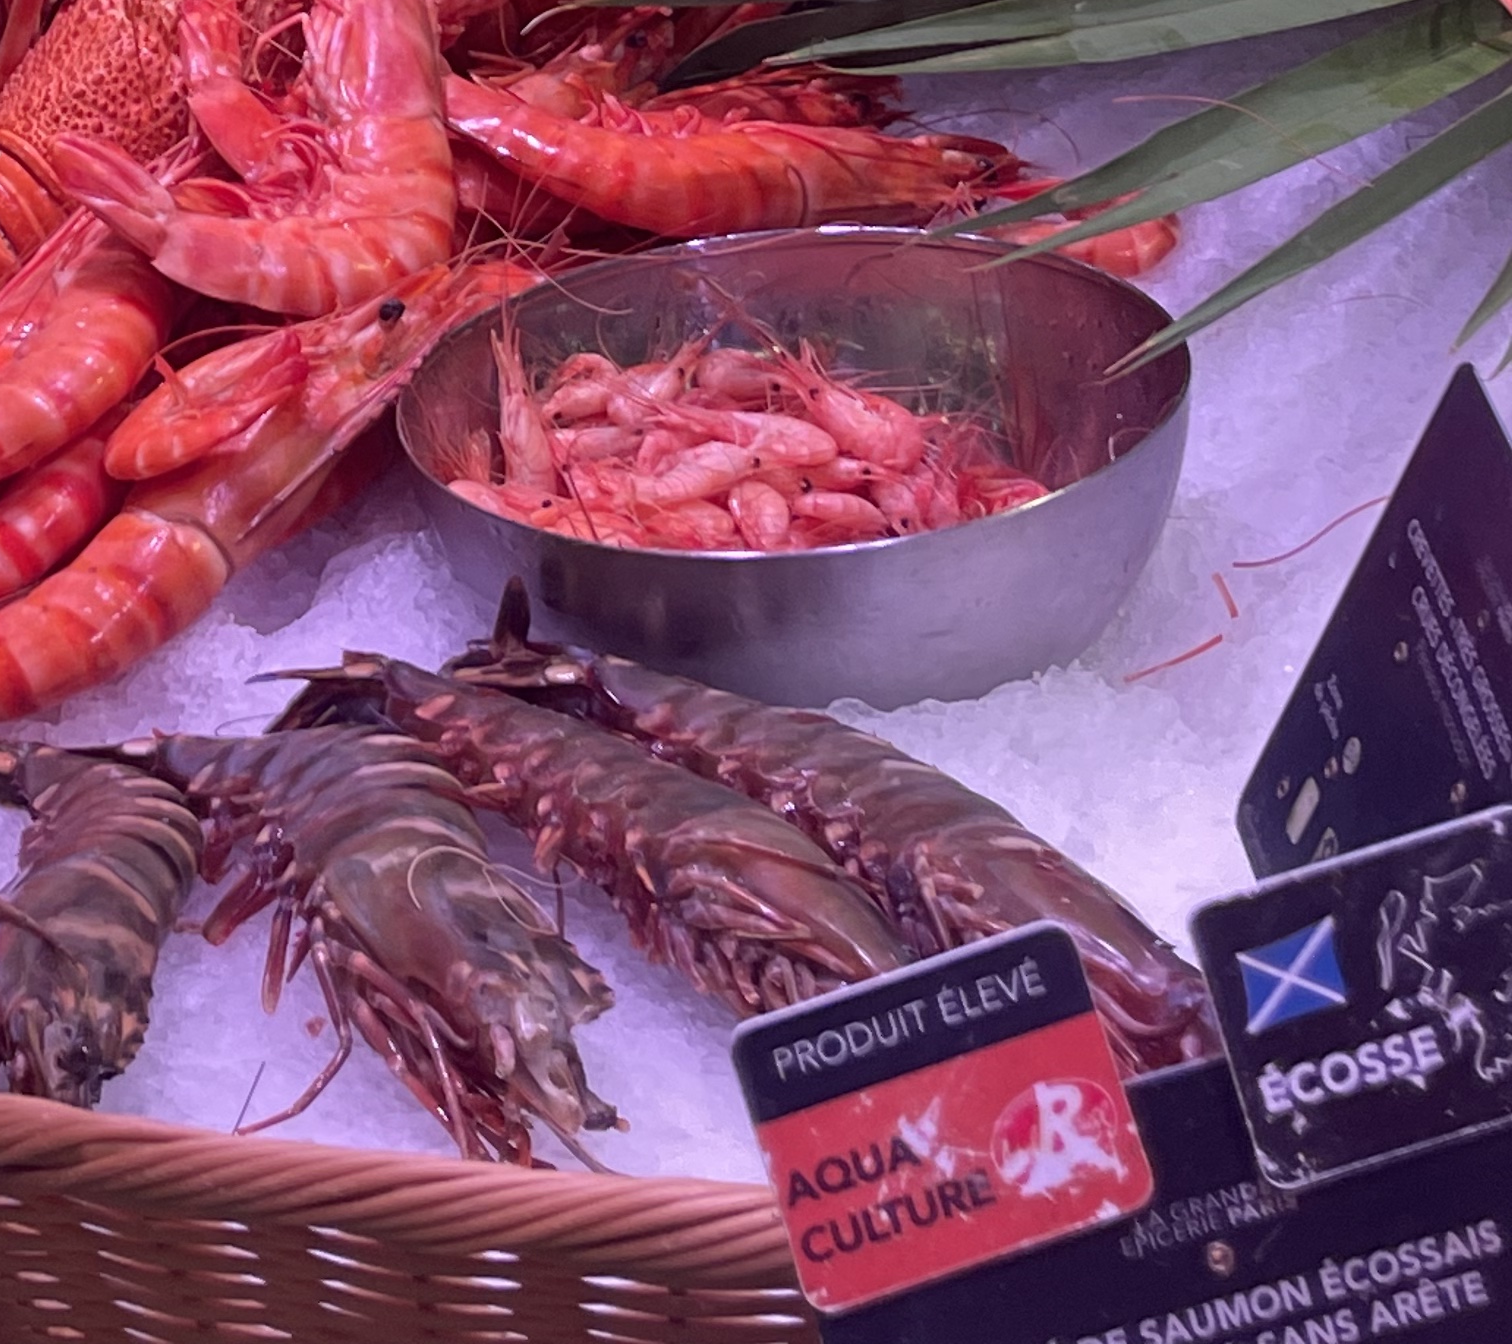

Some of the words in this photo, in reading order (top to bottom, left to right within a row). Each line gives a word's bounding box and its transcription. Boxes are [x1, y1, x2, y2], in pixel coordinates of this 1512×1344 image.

[1407, 518, 1456, 618] CREVETTES
[772, 997, 929, 1083] PRODUIT
[937, 955, 1048, 1026] ÉLEVÉ
[1257, 1025, 1445, 1114] ÉCOSSE
[787, 1134, 922, 1208] AQUA
[801, 1167, 999, 1264] CULTURE
[1139, 1275, 1313, 1344] SAUMON
[1318, 1219, 1503, 1300] ÉCOSSAIS
[1371, 1270, 1490, 1335] ARÊTE
